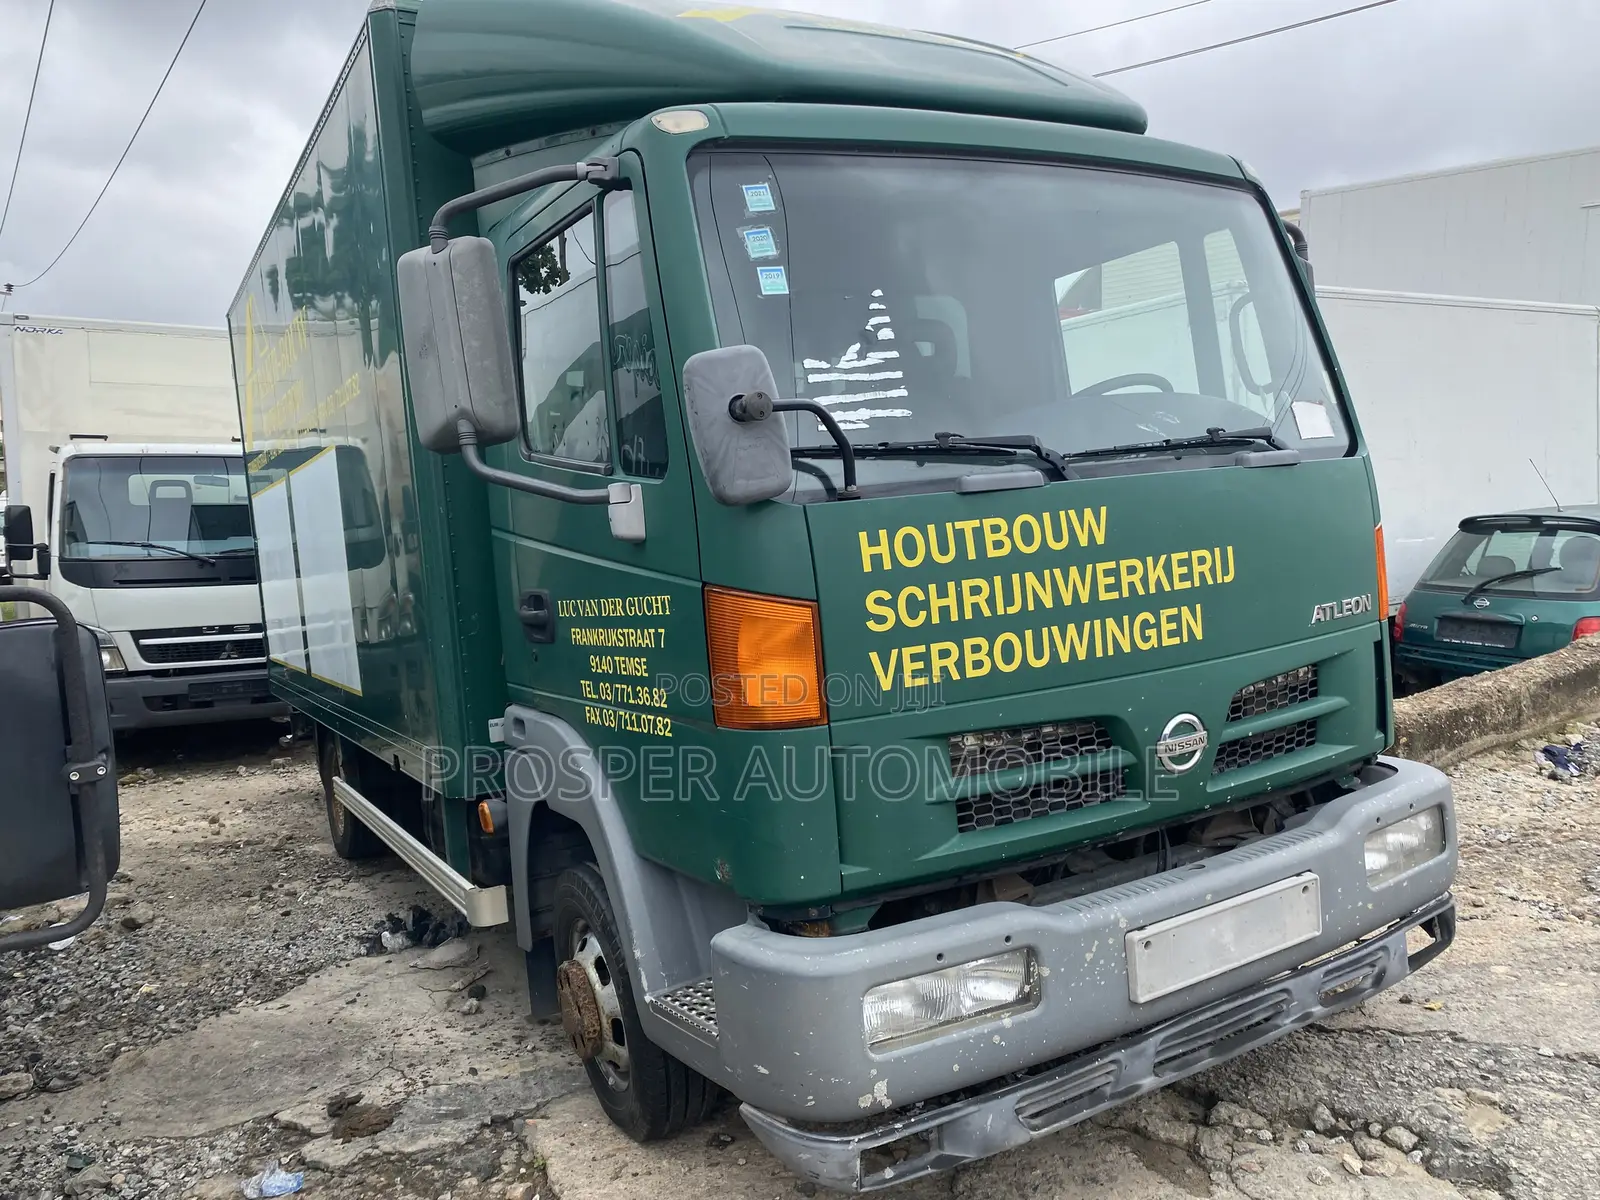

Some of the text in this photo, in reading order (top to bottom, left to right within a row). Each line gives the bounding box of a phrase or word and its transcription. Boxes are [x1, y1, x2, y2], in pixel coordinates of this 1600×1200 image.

[751, 234, 768, 242] 2020
[764, 272, 780, 280] 2019
[858, 505, 1107, 572] HOUTBOUW
[865, 545, 1235, 632] SCHRIJNWERKERIJ
[557, 595, 671, 617] LUC VAN DER GUCHT
[1310, 594, 1372, 625] ATLEON
[570, 628, 665, 649] FRANKRIJKSTRAAT 7
[869, 603, 1203, 691] VERBOUWINGEN
[589, 654, 649, 677] 9140 TEMSE
[580, 680, 668, 708] TEL. 03/771.36.82
[584, 706, 673, 737] FAX 03/711.07.82
[1164, 735, 1205, 753] NISSAN
